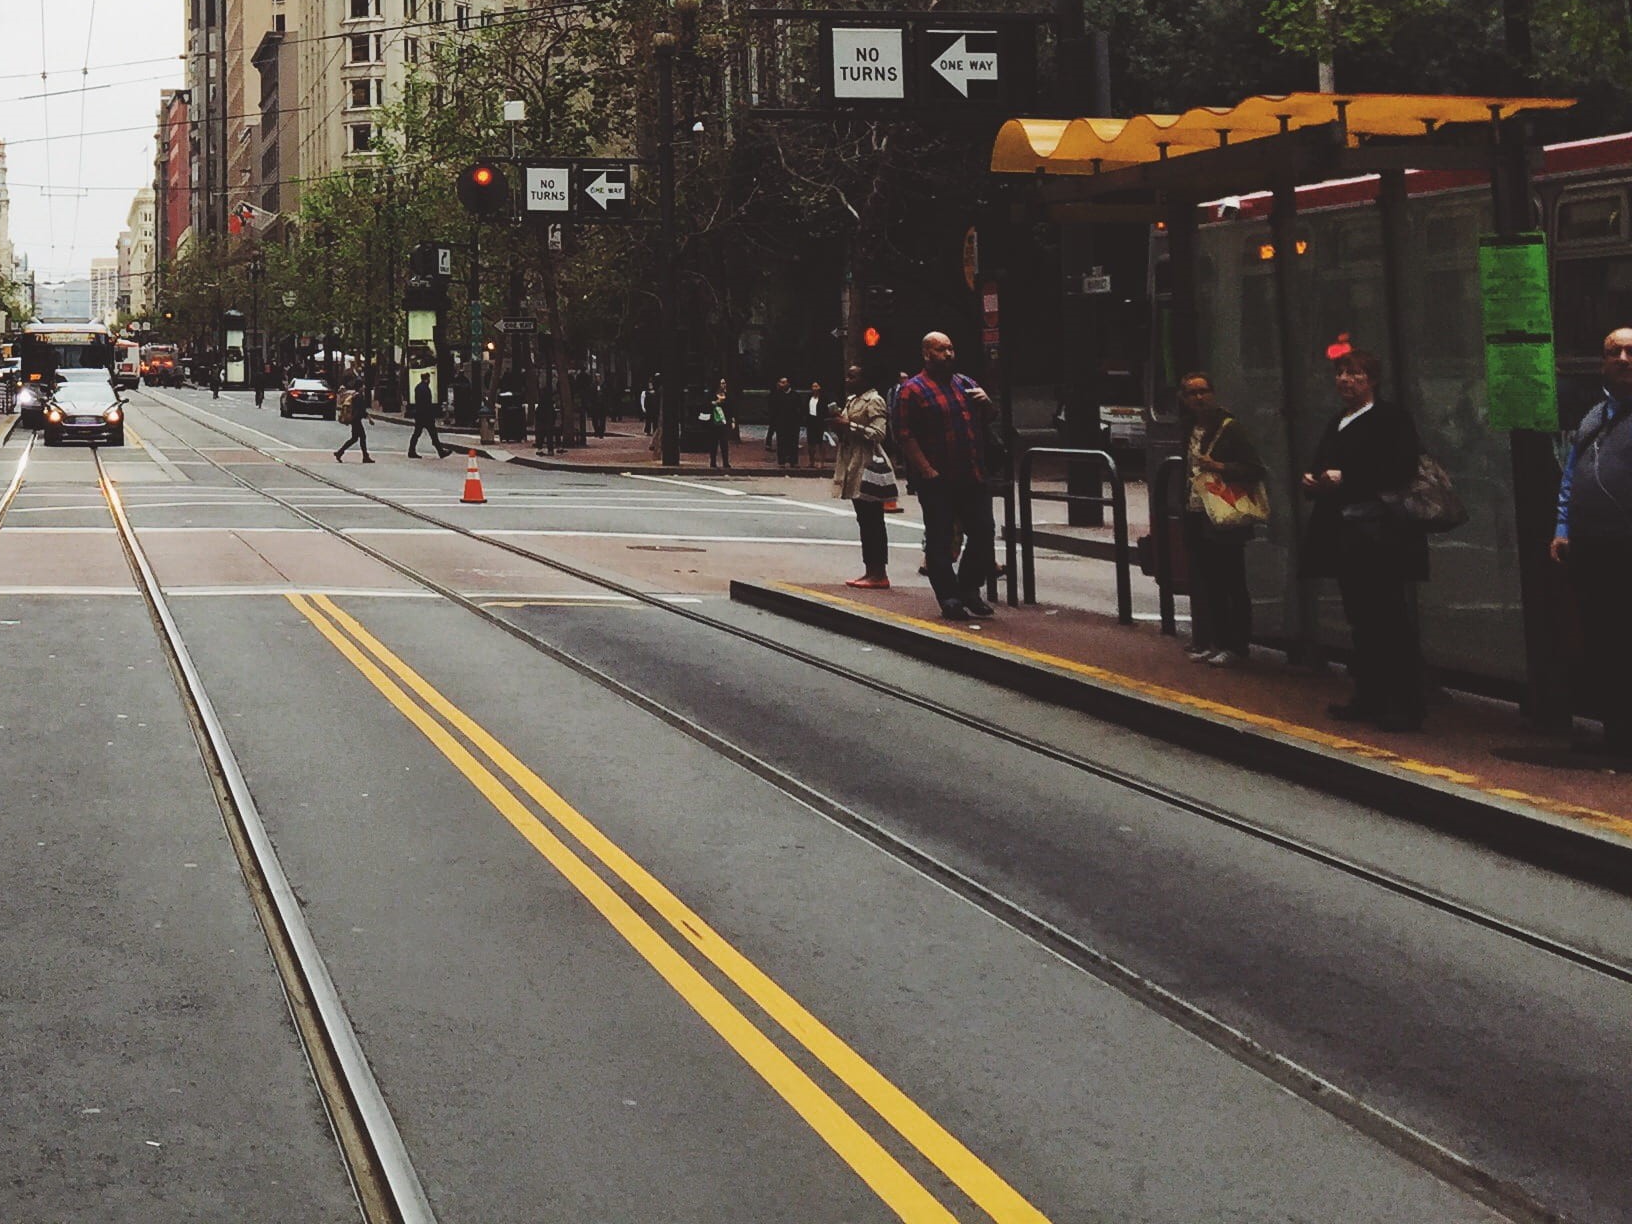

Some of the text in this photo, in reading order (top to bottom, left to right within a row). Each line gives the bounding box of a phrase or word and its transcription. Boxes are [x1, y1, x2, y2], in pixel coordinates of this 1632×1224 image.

[855, 47, 880, 62] NO
[940, 59, 994, 71] ONE WAY
[839, 66, 898, 82] TURNS
[540, 179, 555, 189] NO
[531, 190, 566, 201] TURNS
[590, 186, 623, 194] ONE WAY
